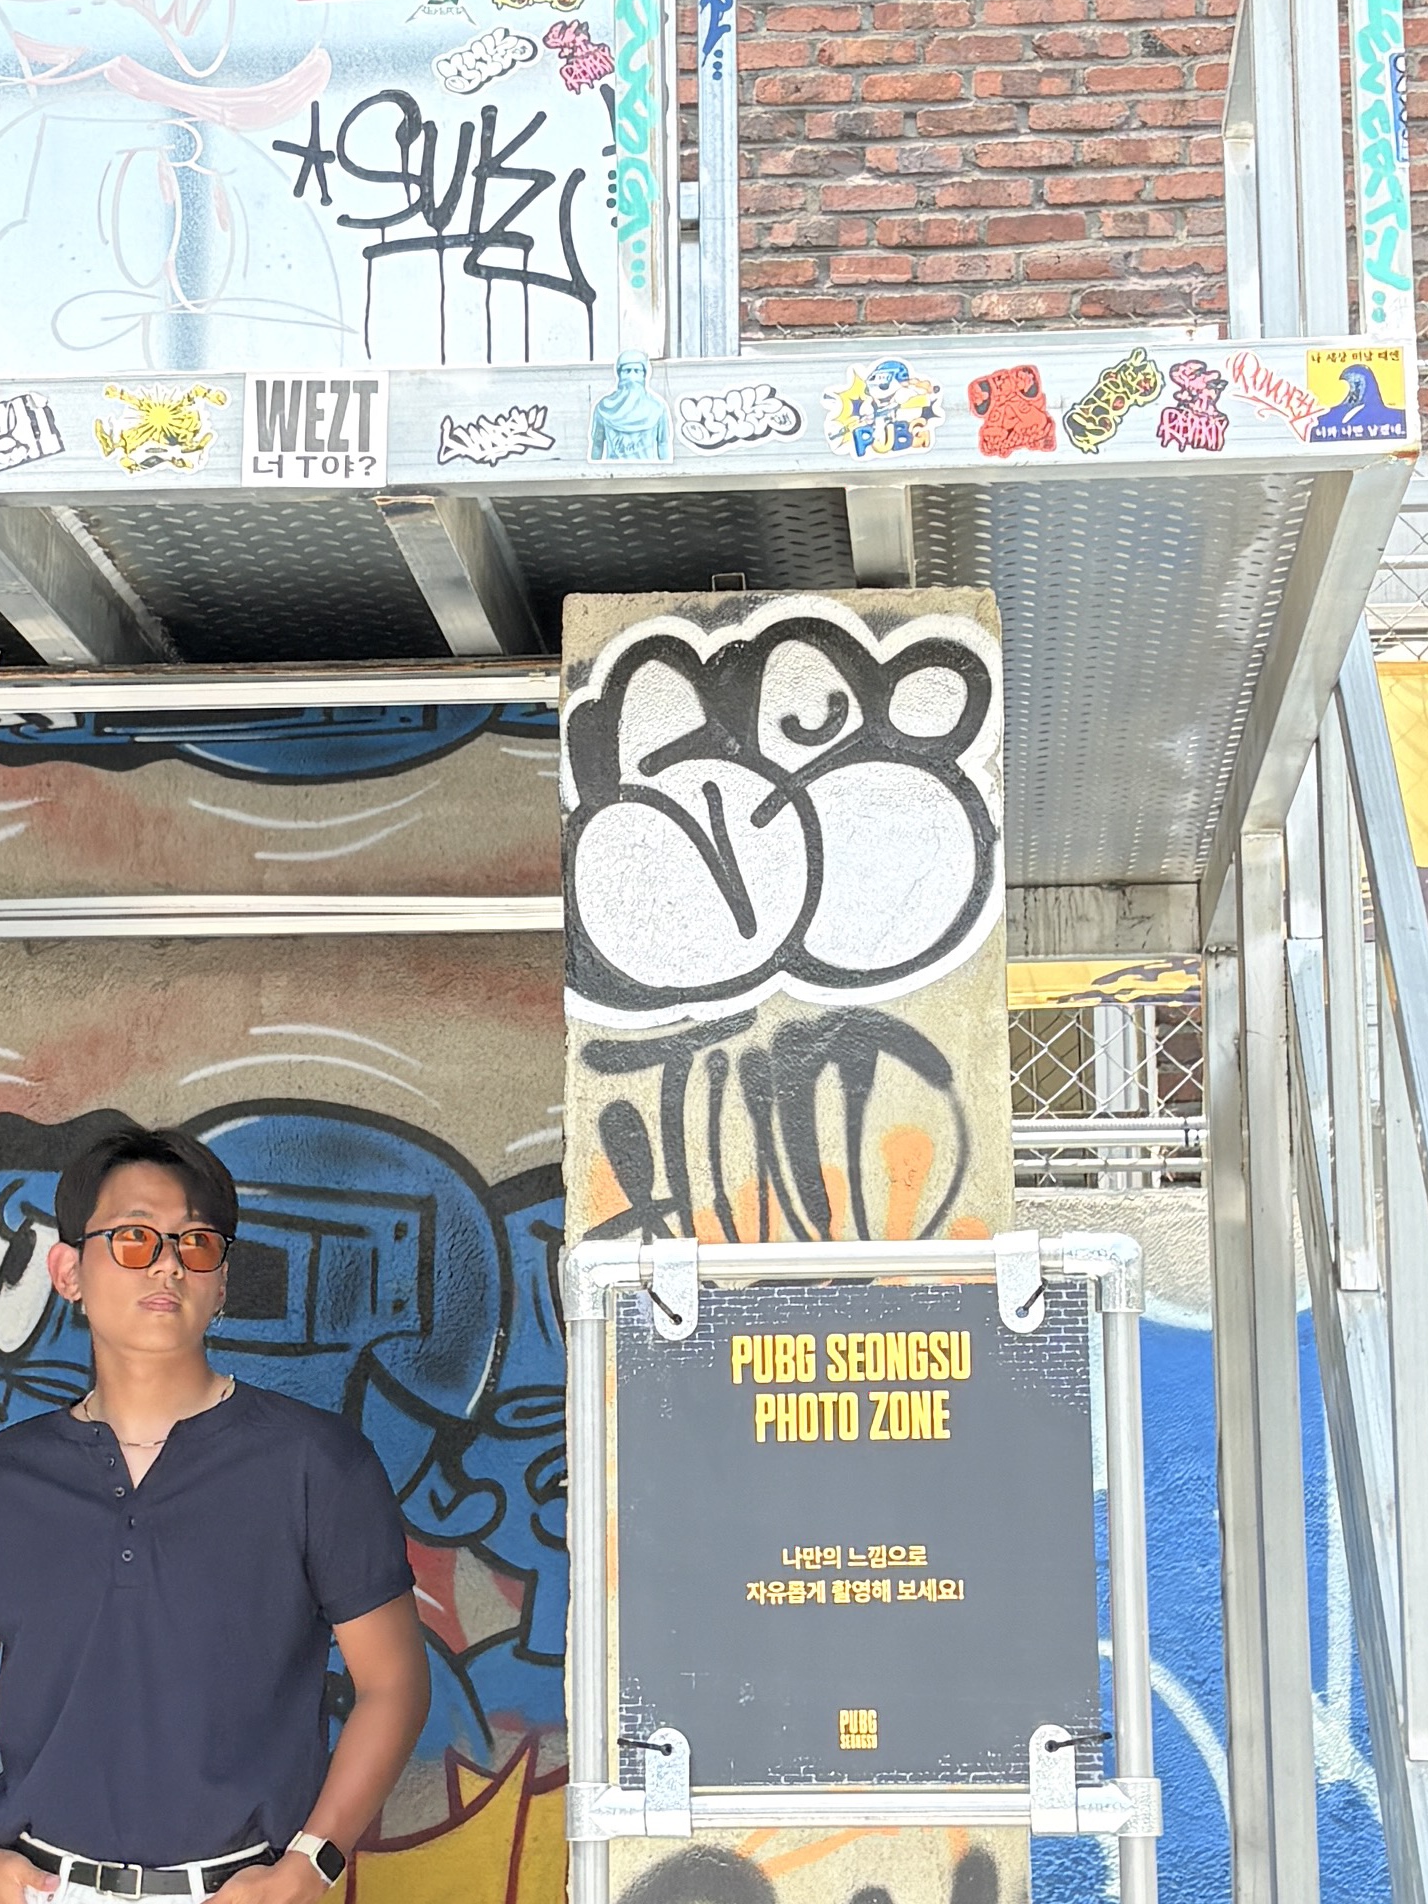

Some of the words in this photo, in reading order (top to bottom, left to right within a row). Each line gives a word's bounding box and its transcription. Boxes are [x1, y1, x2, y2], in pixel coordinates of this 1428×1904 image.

[255, 379, 379, 452] WEZT
[252, 455, 284, 479] 너
[730, 1333, 816, 1385] PUBG
[825, 1331, 971, 1383] SEONGSU
[754, 1391, 860, 1443] PHOTO
[869, 1390, 951, 1441] ZONE
[781, 1545, 842, 1570] 나만의
[847, 1544, 929, 1569] 느낌으로
[746, 1579, 827, 1605] 자유롭게
[831, 1578, 890, 1604] 촬영해
[896, 1579, 965, 1601] 보세요!
[838, 1709, 877, 1734] PUBG
[838, 1734, 878, 1751] SEONGSU
